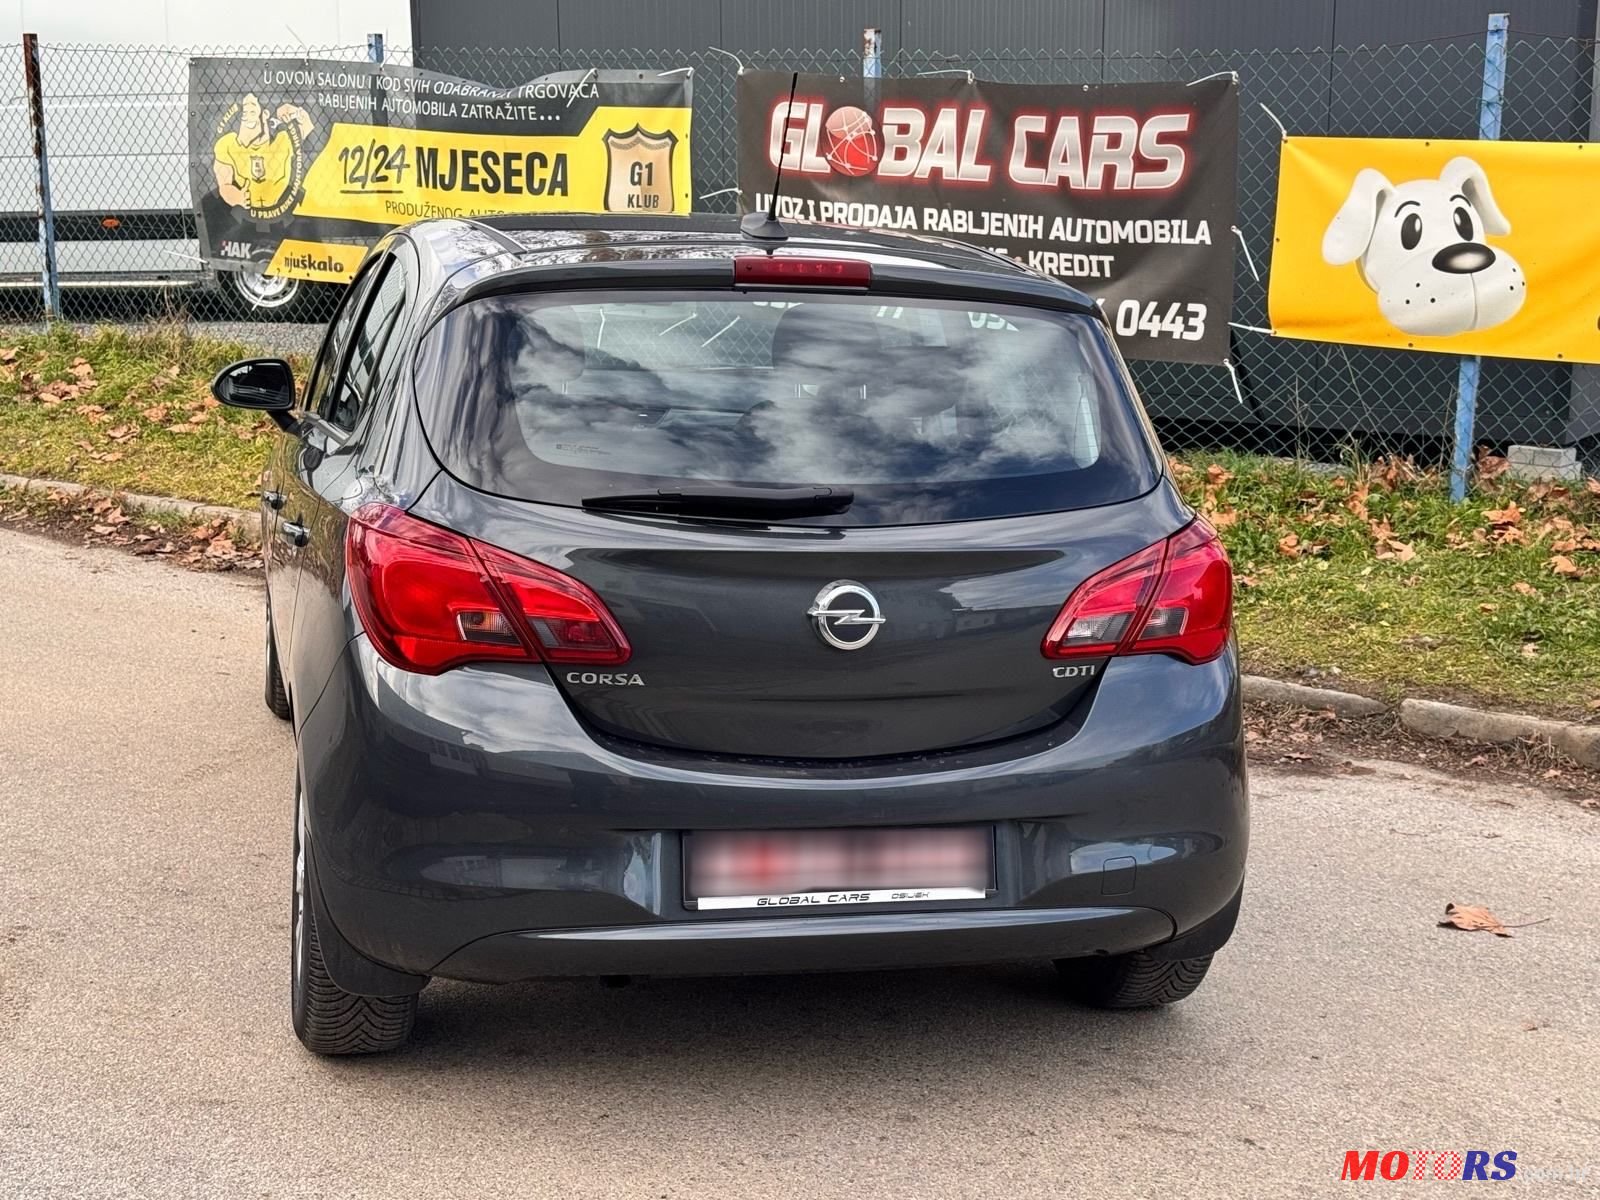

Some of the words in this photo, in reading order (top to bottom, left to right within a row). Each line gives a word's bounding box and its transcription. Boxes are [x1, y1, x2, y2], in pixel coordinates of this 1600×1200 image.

[263, 71, 272, 85] U
[275, 71, 316, 87] OVOM
[317, 72, 367, 90] SALONU
[367, 75, 373, 90] I
[376, 76, 402, 93] KOD
[404, 78, 432, 95] SVIH
[318, 93, 377, 112] RABLJENIH
[381, 98, 458, 118] AUTOMOBILA
[768, 100, 992, 183] GLOBAL
[1008, 113, 1191, 190] CARS
[338, 138, 411, 190] 12/24
[415, 146, 569, 197] MJESECA
[630, 161, 653, 187] G1
[386, 199, 463, 219] PRODUŽENOG
[627, 193, 660, 209] KLUB
[257, 208, 281, 219] PRAVE
[806, 199, 817, 222] I
[819, 200, 918, 230] PRODAJA
[922, 206, 1044, 240] RABLJENIH
[1048, 216, 1213, 246] AUTOMOBILA
[220, 240, 252, 260] HAK
[283, 252, 345, 274] njuškalo
[1028, 250, 1115, 278] KREDIT
[1115, 299, 1208, 341] 0443
[566, 671, 646, 686] CORSA
[1052, 664, 1096, 678] CDTI
[756, 895, 821, 907] GLOBAL
[827, 893, 871, 904] CARS
